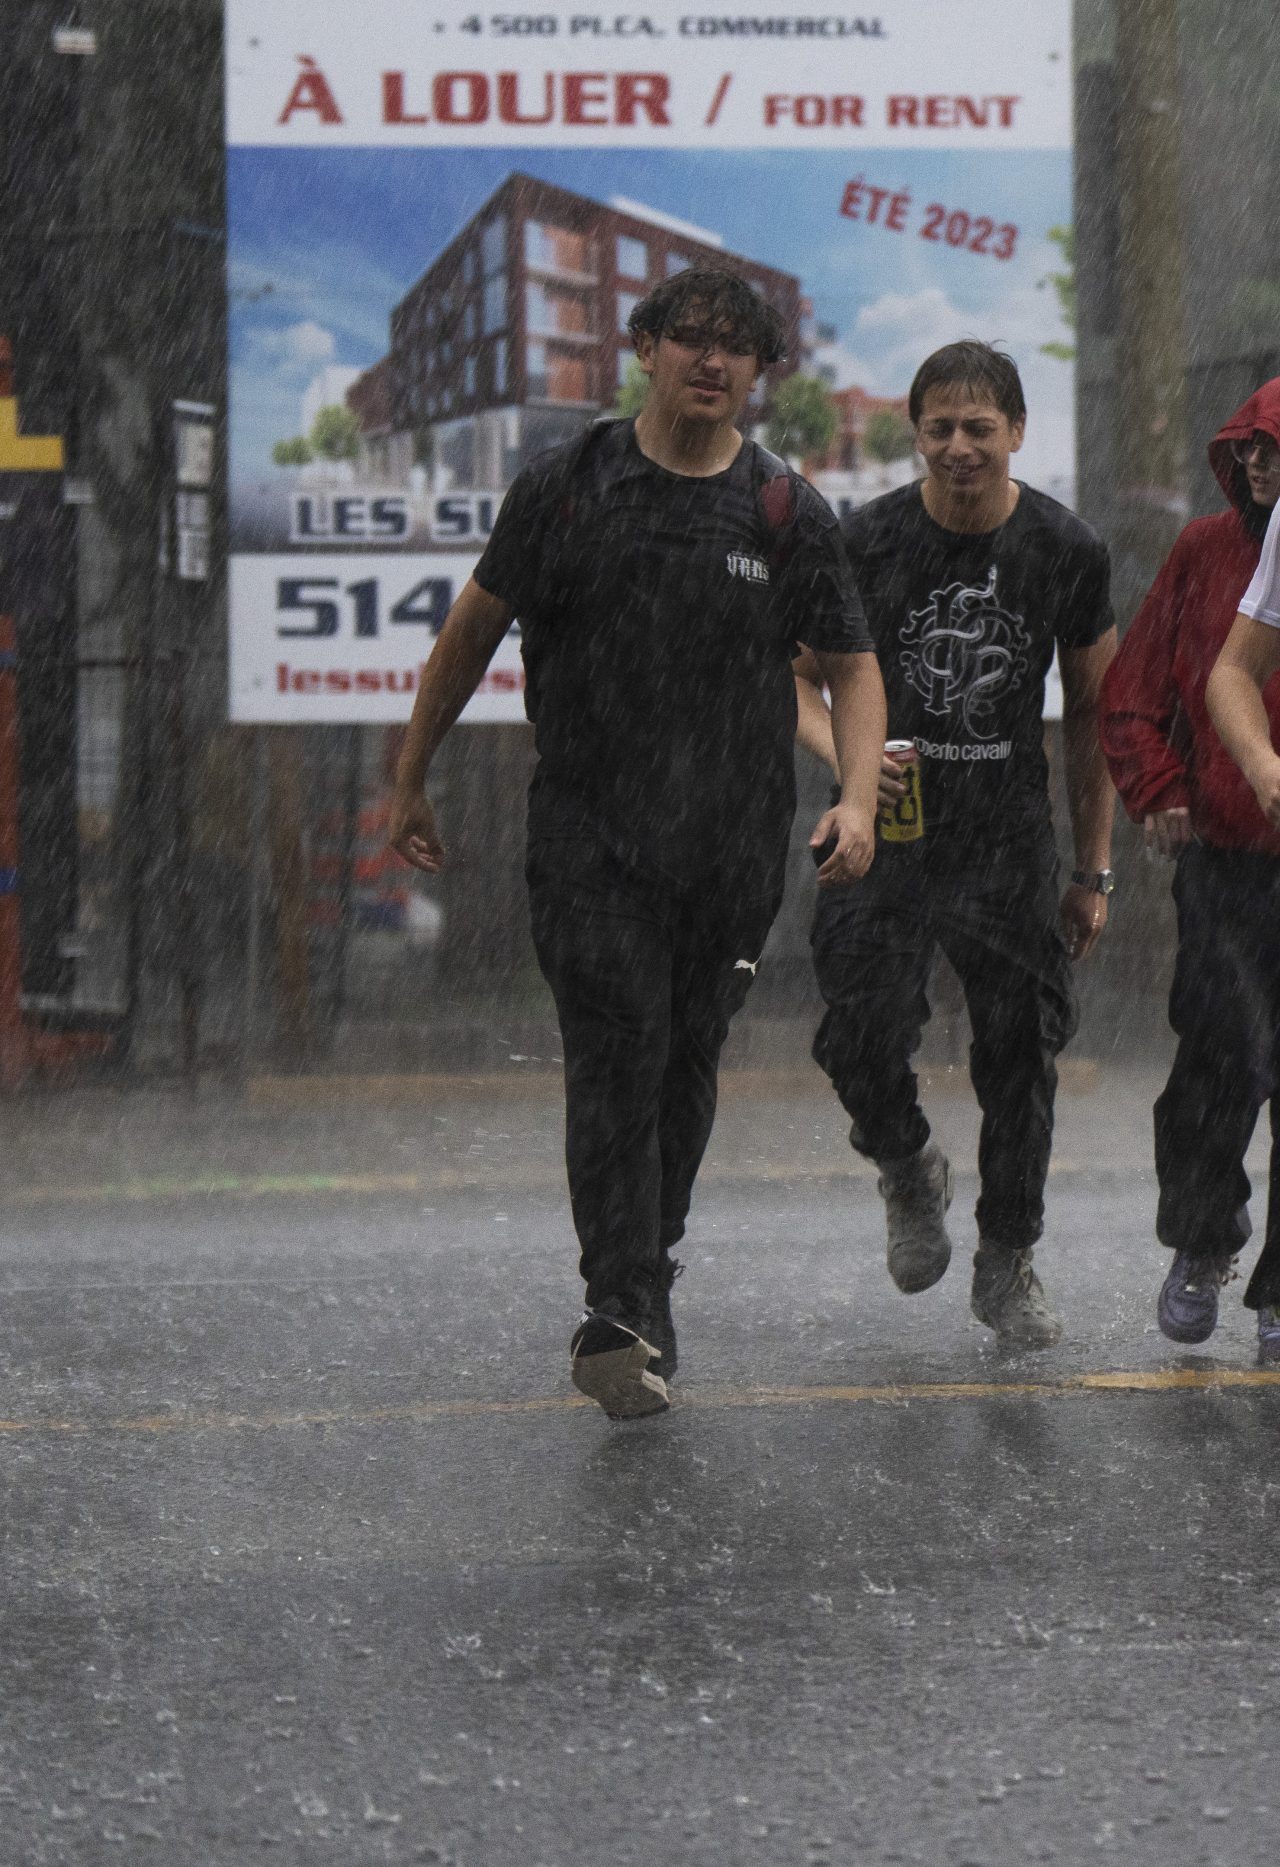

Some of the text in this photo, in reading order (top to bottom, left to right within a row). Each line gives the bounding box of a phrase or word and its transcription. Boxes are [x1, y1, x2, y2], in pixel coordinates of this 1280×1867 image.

[678, 14, 888, 39] COMMERCIAL
[277, 53, 1022, 128] À LOUER / FOR RENT
[838, 173, 1019, 260] ÉTÉ 2023
[294, 494, 410, 539] LES
[960, 740, 1013, 761] cavalli
